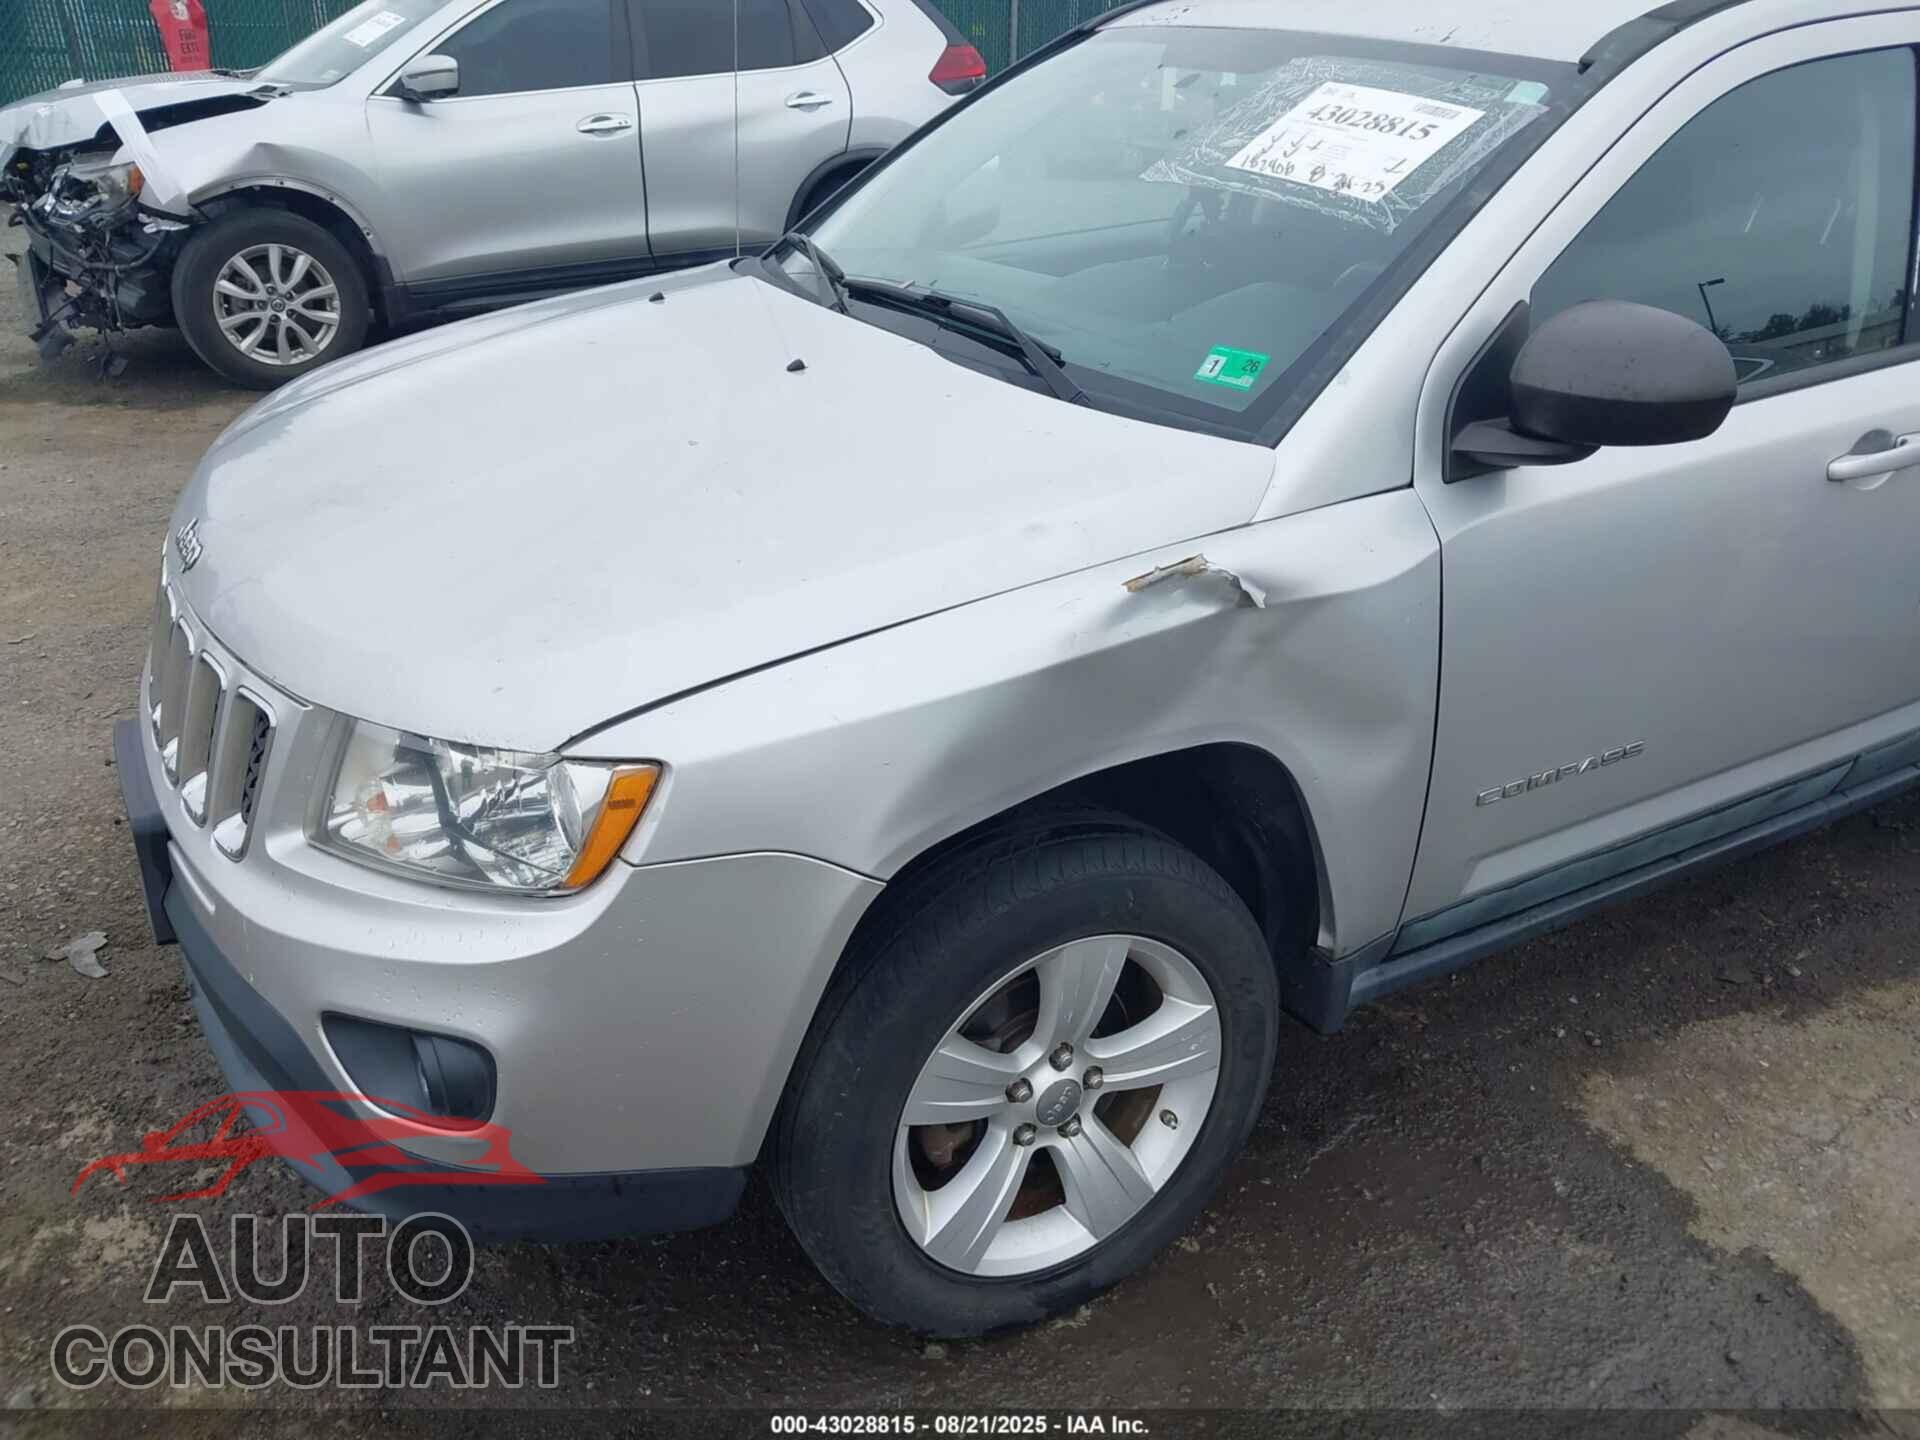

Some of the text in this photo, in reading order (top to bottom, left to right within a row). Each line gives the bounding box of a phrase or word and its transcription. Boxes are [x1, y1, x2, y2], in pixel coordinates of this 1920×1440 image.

[1306, 103, 1440, 141] 43028815
[1208, 358, 1261, 374] 1 26
[1475, 738, 1646, 808] COMPASS
